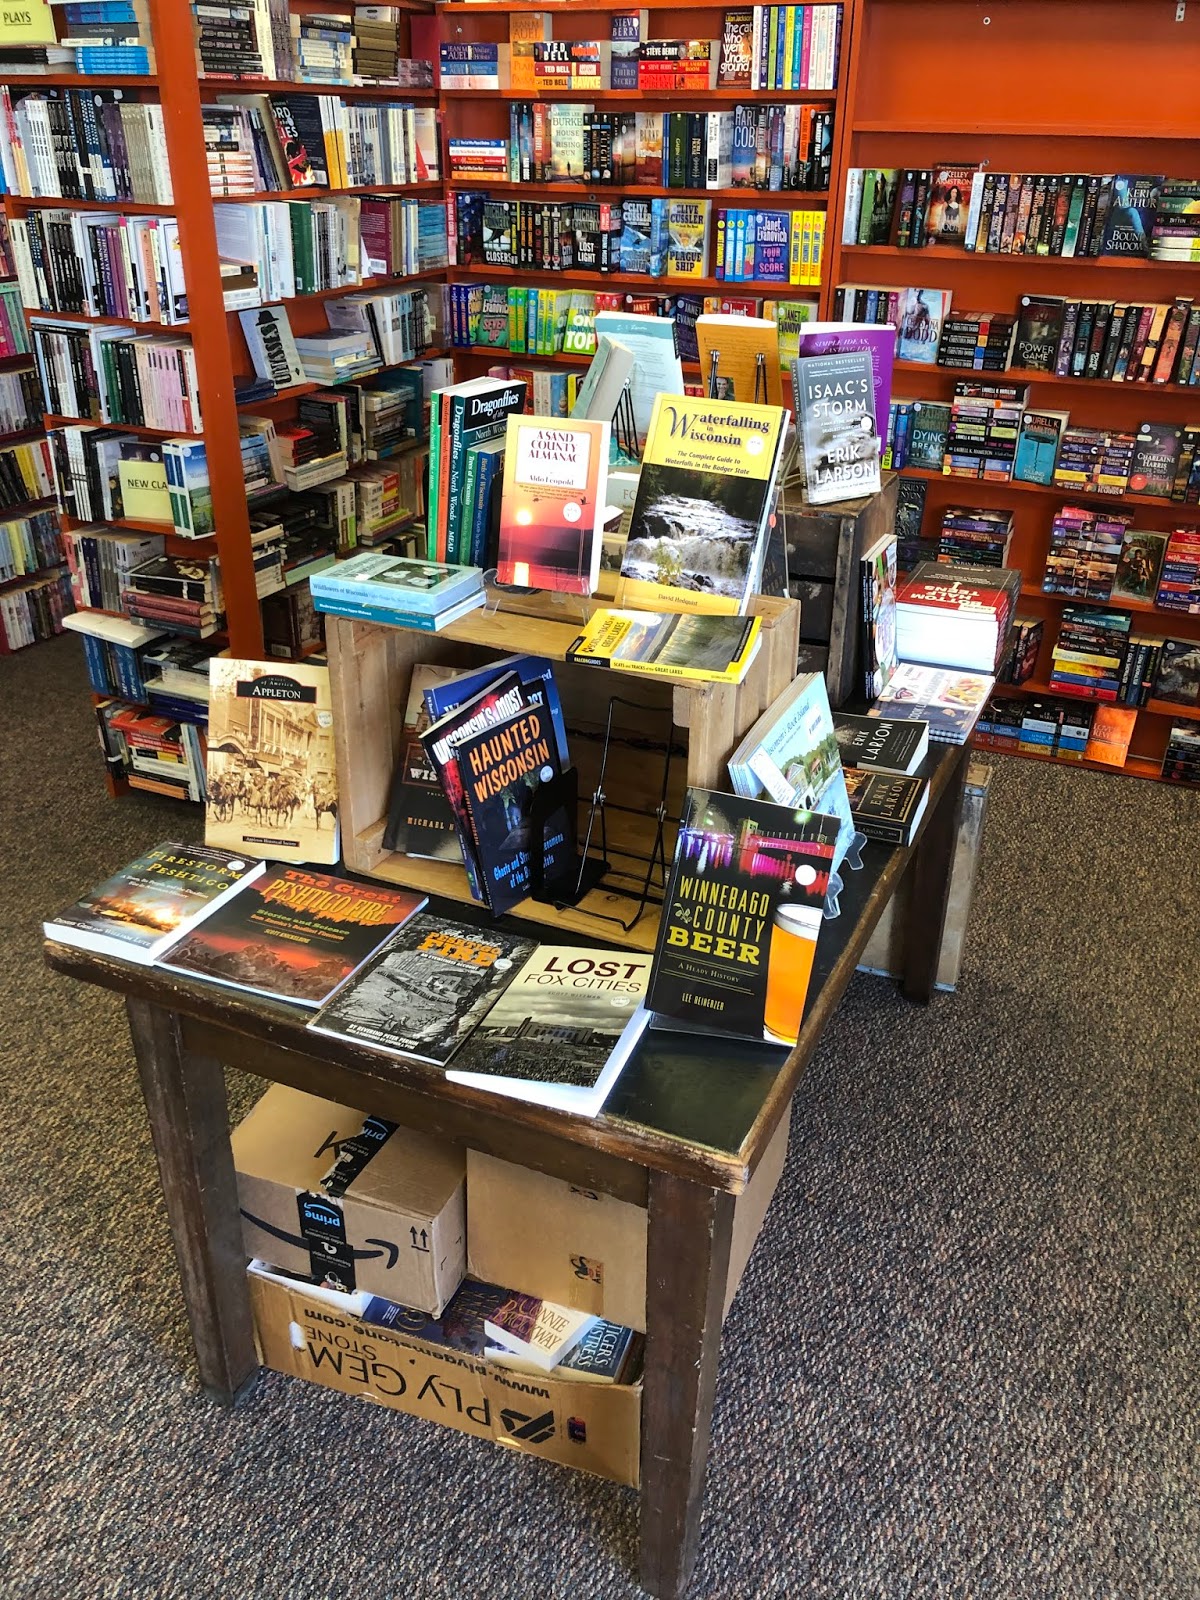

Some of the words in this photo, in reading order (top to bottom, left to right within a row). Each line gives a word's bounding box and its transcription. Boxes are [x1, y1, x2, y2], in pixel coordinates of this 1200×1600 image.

[4, 12, 31, 23] PLAYS
[613, 27, 639, 37] BERRY
[725, 22, 740, 33] The
[724, 33, 742, 43] Who
[546, 42, 565, 52] TED
[646, 46, 661, 56] STEVE
[662, 46, 678, 56] BERRY
[544, 52, 569, 61] BELL
[544, 66, 556, 74] TED
[613, 68, 636, 77] THIRD
[613, 77, 636, 85] SECRET
[552, 117, 583, 126] BURKE
[1126, 188, 1150, 198] KERI
[1112, 196, 1157, 208] ARTHUR
[670, 214, 703, 224] CUSSLER
[765, 218, 782, 230] Janet
[757, 229, 787, 242] Evanovich
[579, 242, 594, 252] LOST
[763, 248, 780, 257] FOUR
[486, 252, 511, 263] CLOSERS
[578, 254, 596, 264] LIGHT
[670, 251, 701, 262] PLAGUE
[675, 261, 694, 272] SHIP
[759, 262, 784, 272] SCORE
[572, 315, 594, 326] ON
[566, 331, 595, 350] TOP
[814, 338, 842, 347] SIMPLE
[261, 323, 293, 384] ULYSSES
[1019, 343, 1054, 354] POWER
[1022, 351, 1048, 362] GAME
[809, 378, 868, 399] ISAAC'S
[471, 388, 520, 416] Dragonflies
[813, 398, 867, 418] STORM
[664, 406, 770, 438] Waterfalling
[452, 405, 464, 459] Dragonflies
[475, 429, 492, 441] North
[537, 431, 546, 440] A
[546, 431, 574, 442] SAND
[913, 430, 947, 443] DYING
[1024, 425, 1057, 437] HAMILTON
[531, 440, 577, 452] COUNTY
[912, 441, 945, 451] BREATH
[528, 450, 577, 462] ALMANAC
[688, 452, 715, 461] Complete
[716, 455, 733, 463] Guide
[826, 446, 860, 464] ERIK
[1137, 452, 1175, 463] CHARLAINE
[665, 457, 693, 467] Waterfalls
[712, 464, 733, 473] Badger
[1143, 460, 1167, 469] HARRIS
[529, 475, 544, 484] Aldo
[545, 476, 574, 486] Leopold
[815, 462, 876, 485] LARSON
[128, 479, 149, 488] NEW
[450, 470, 459, 493] North
[465, 477, 473, 505] Wisconsin
[478, 481, 486, 510] Wisconsin
[450, 496, 458, 520] Woods
[313, 584, 339, 593] Wildflowers
[345, 588, 368, 597] Wisconsin
[658, 594, 674, 602] David
[252, 685, 300, 699] APPLETON
[432, 708, 495, 766] WISCONSIN'S
[494, 686, 524, 719] MOST
[469, 714, 541, 776] HAUNTED
[852, 730, 870, 747] ERIK
[862, 722, 894, 761] LARSON
[473, 740, 550, 803] WISCONSIN
[870, 783, 890, 806] ERIK
[880, 780, 907, 817] LARSON
[407, 817, 444, 830] MICHAEL
[858, 824, 884, 836] LARSON
[147, 850, 244, 880] FIRESTORM
[147, 863, 230, 890] PESHTIGO
[494, 864, 510, 882] Ghosts
[510, 876, 516, 889] of
[516, 872, 524, 884] the
[284, 870, 330, 888] The
[334, 884, 401, 904] Great
[261, 879, 351, 913] PESHTIGO
[348, 898, 394, 922] FIRE
[680, 875, 770, 918] WINNEBAGO
[256, 909, 292, 922] Stories
[293, 918, 312, 927] and
[312, 922, 350, 935] Science
[693, 906, 766, 942] COUNTY
[425, 932, 502, 956] PESHTIGO
[666, 926, 761, 965] BEER
[418, 938, 498, 967] FIRE
[428, 954, 456, 966] EYEWITNESS
[456, 962, 480, 970] ACCOUNT
[544, 956, 646, 979] LOST
[686, 964, 709, 976] HEADY
[711, 970, 740, 984] HISTORY
[524, 974, 568, 985] FOX
[572, 977, 642, 993] CITIES
[682, 993, 693, 1004] LEE
[357, 1026, 383, 1037] REVEREND
[399, 1036, 420, 1046] PERNIN
[305, 1209, 341, 1228] prime
[519, 1300, 570, 1333] CONNIE
[493, 1300, 562, 1350] BROCKWAY
[305, 1324, 376, 1361] STONE
[596, 1320, 624, 1367] TIGER'S
[304, 1309, 550, 1400] www.plygemstone.com
[306, 1342, 407, 1396] GEM
